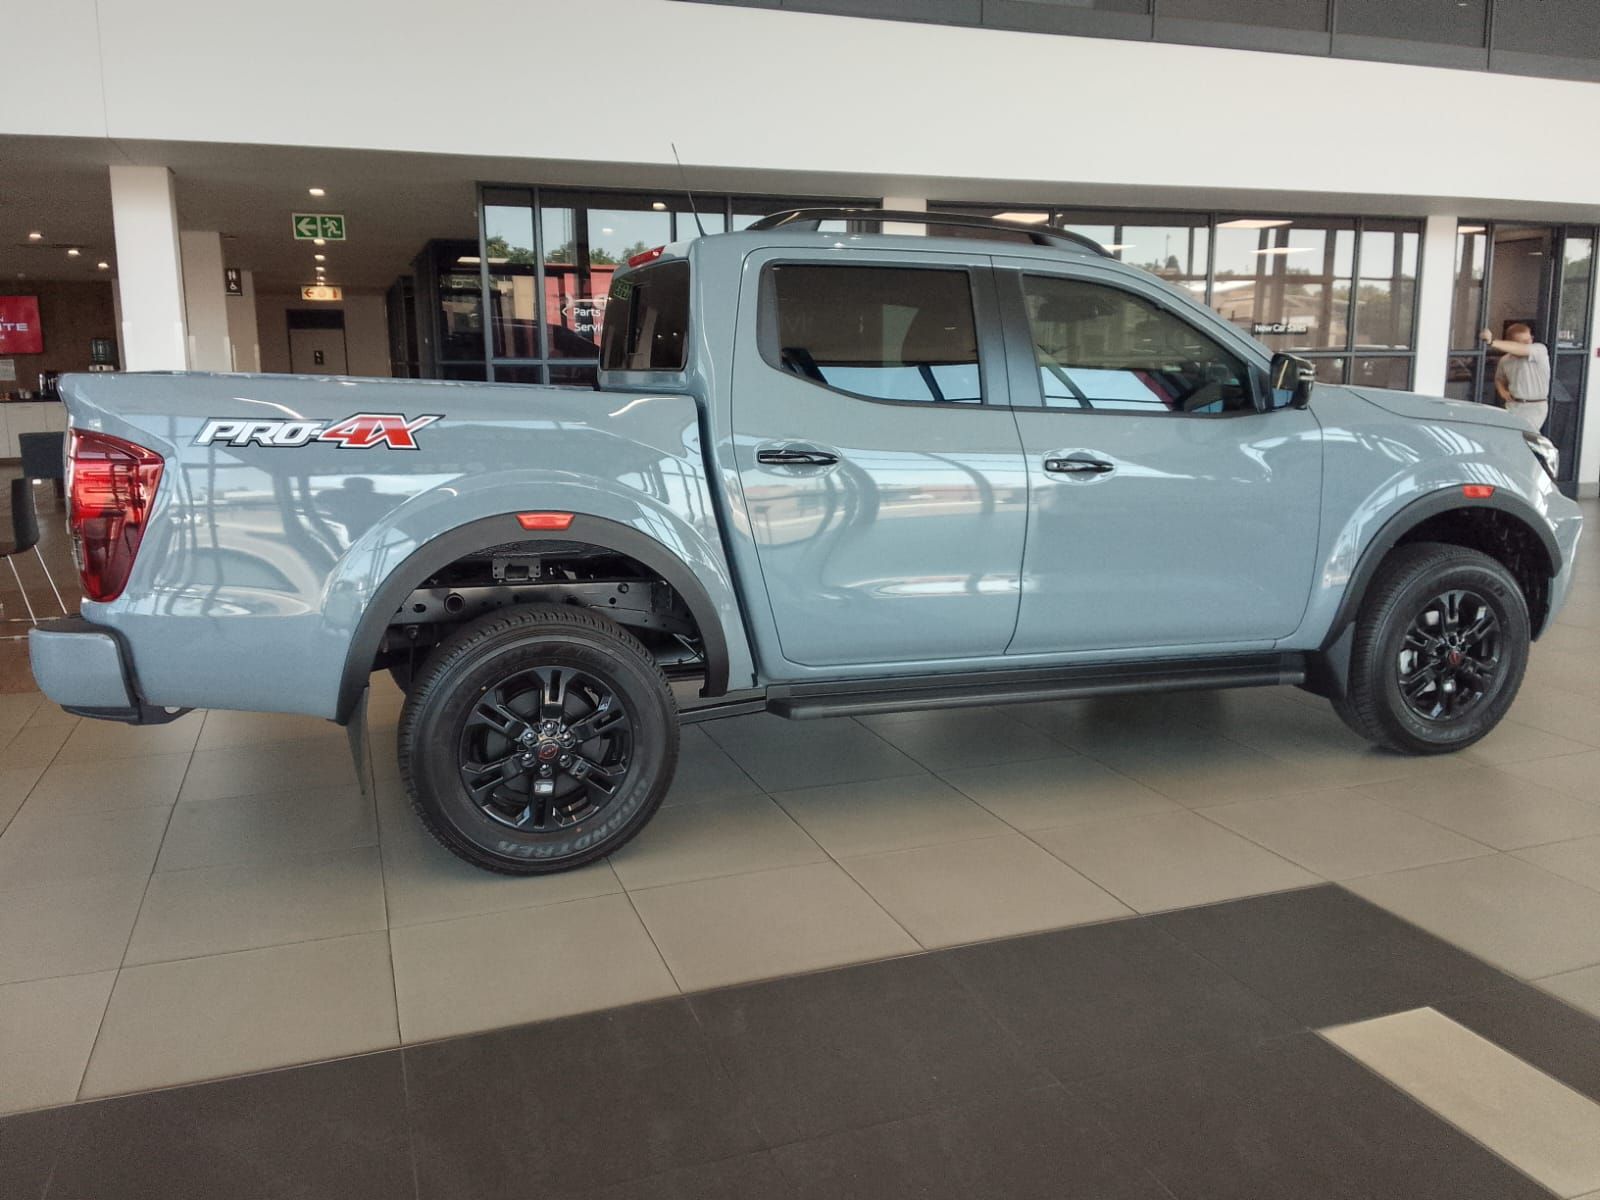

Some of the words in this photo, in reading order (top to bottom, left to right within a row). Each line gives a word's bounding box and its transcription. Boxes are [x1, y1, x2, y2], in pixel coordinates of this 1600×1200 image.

[573, 307, 601, 317] Parts
[574, 322, 603, 332] Servi
[1254, 324, 1272, 333] New
[1272, 323, 1286, 333] Car
[191, 412, 446, 450] PRO-4X
